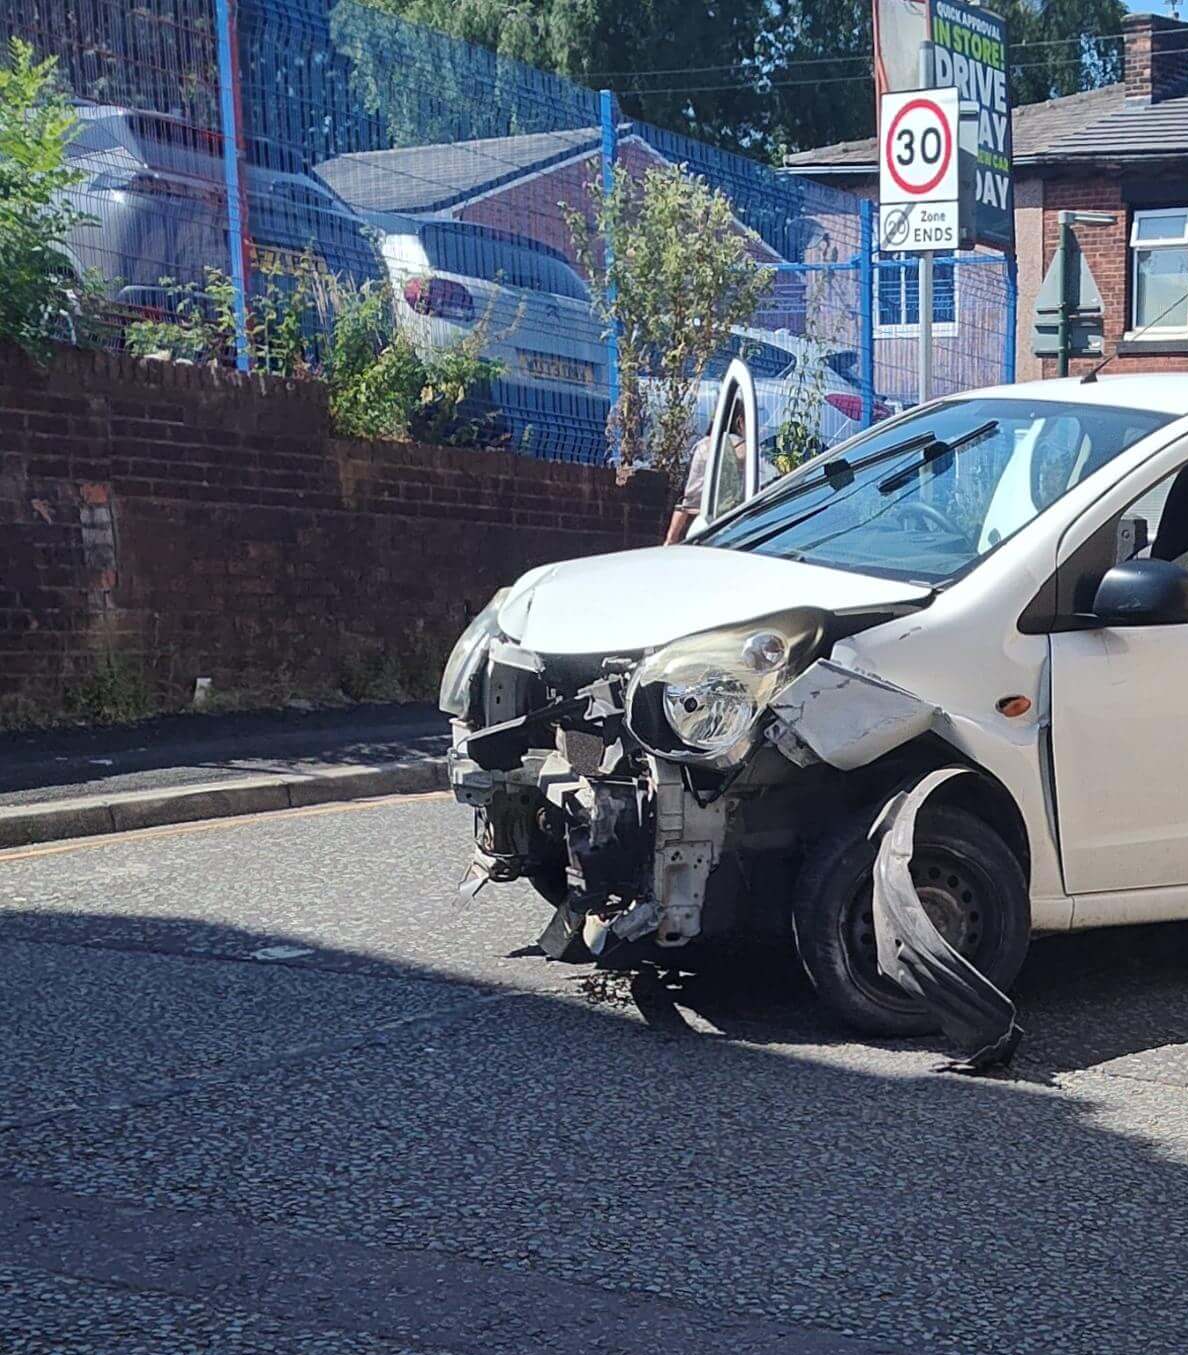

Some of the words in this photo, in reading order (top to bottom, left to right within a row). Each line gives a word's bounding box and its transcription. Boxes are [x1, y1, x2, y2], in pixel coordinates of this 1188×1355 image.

[933, 16, 951, 48] IN
[953, 25, 1005, 71] STORE!
[934, 45, 1007, 113] DRIVE
[896, 127, 942, 166] 30
[914, 227, 953, 242] ENDS
[920, 210, 946, 222] Zone
